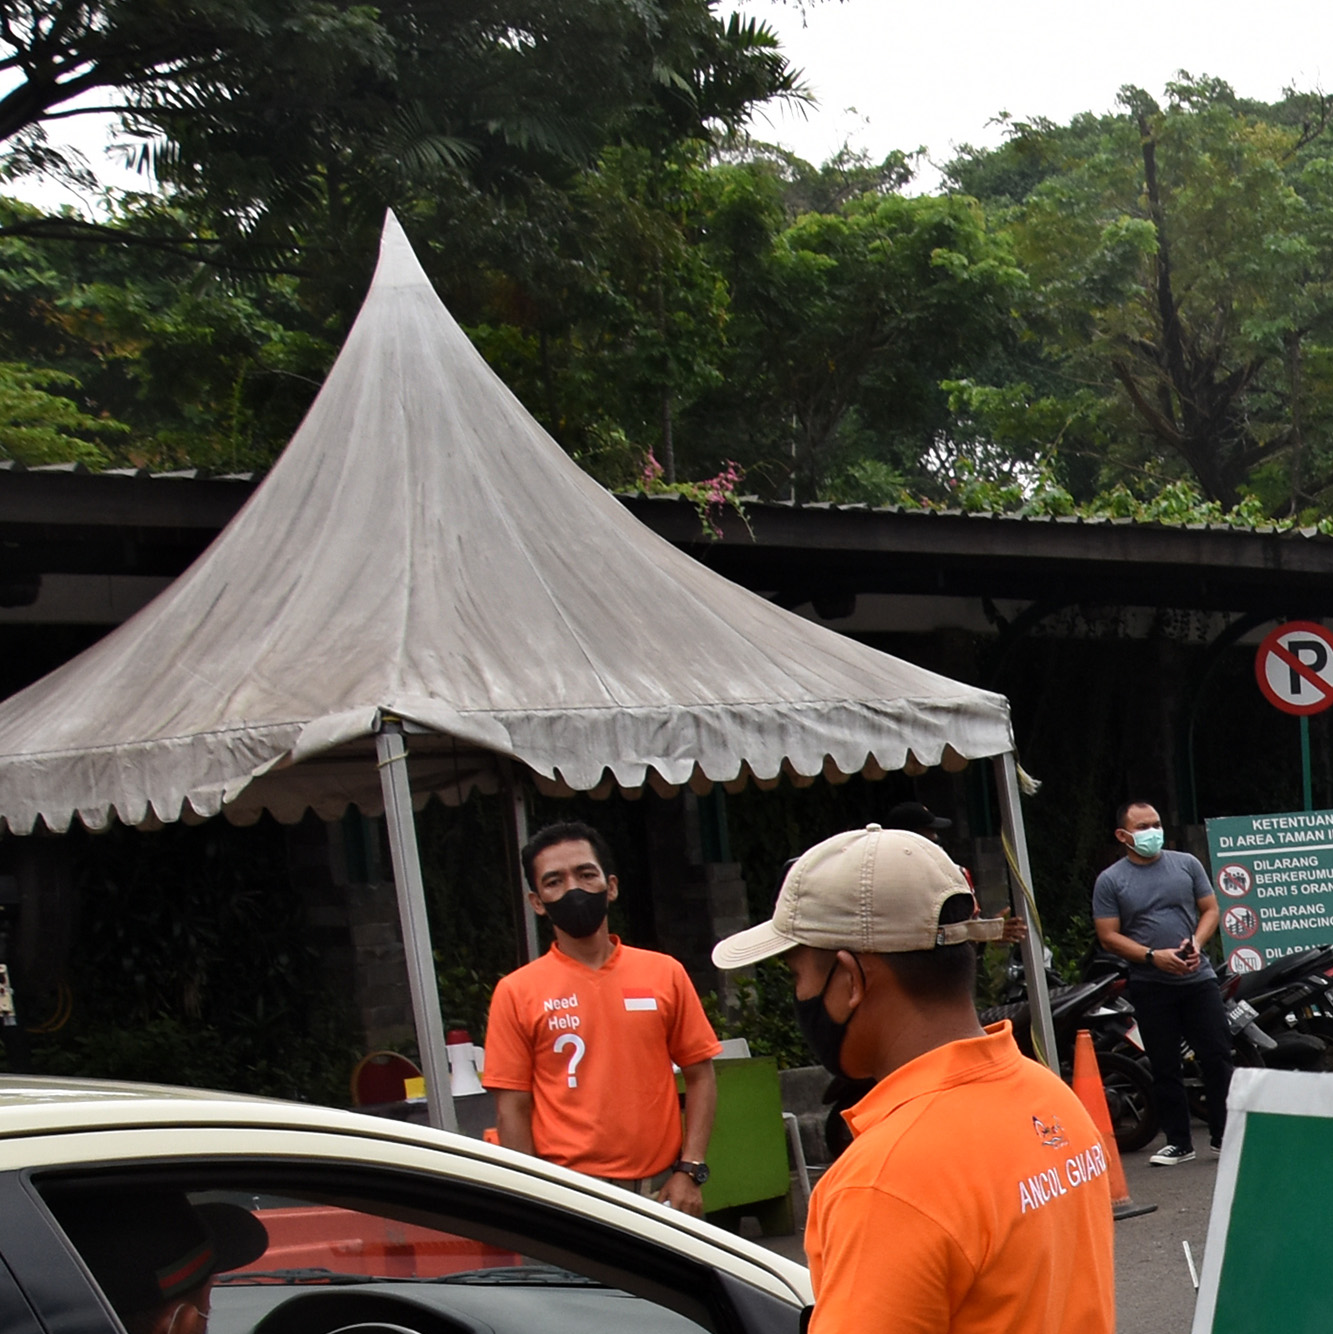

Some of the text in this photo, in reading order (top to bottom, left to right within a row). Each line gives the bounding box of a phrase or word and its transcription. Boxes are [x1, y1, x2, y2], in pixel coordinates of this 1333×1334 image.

[1288, 641, 1327, 694] P
[1219, 836, 1234, 848] DI
[1236, 834, 1276, 847] AREA
[1277, 830, 1325, 844] TAMAN
[1253, 856, 1319, 871] DILARANG
[1257, 886, 1288, 898] DARI
[1291, 884, 1298, 895] 5
[1260, 903, 1325, 919] DILARANG
[1265, 943, 1333, 959] DILAR
[543, 993, 579, 1012] Need
[548, 1013, 581, 1031] Help
[553, 1033, 586, 1089] ?
[1019, 1167, 1067, 1214] ANCOL
